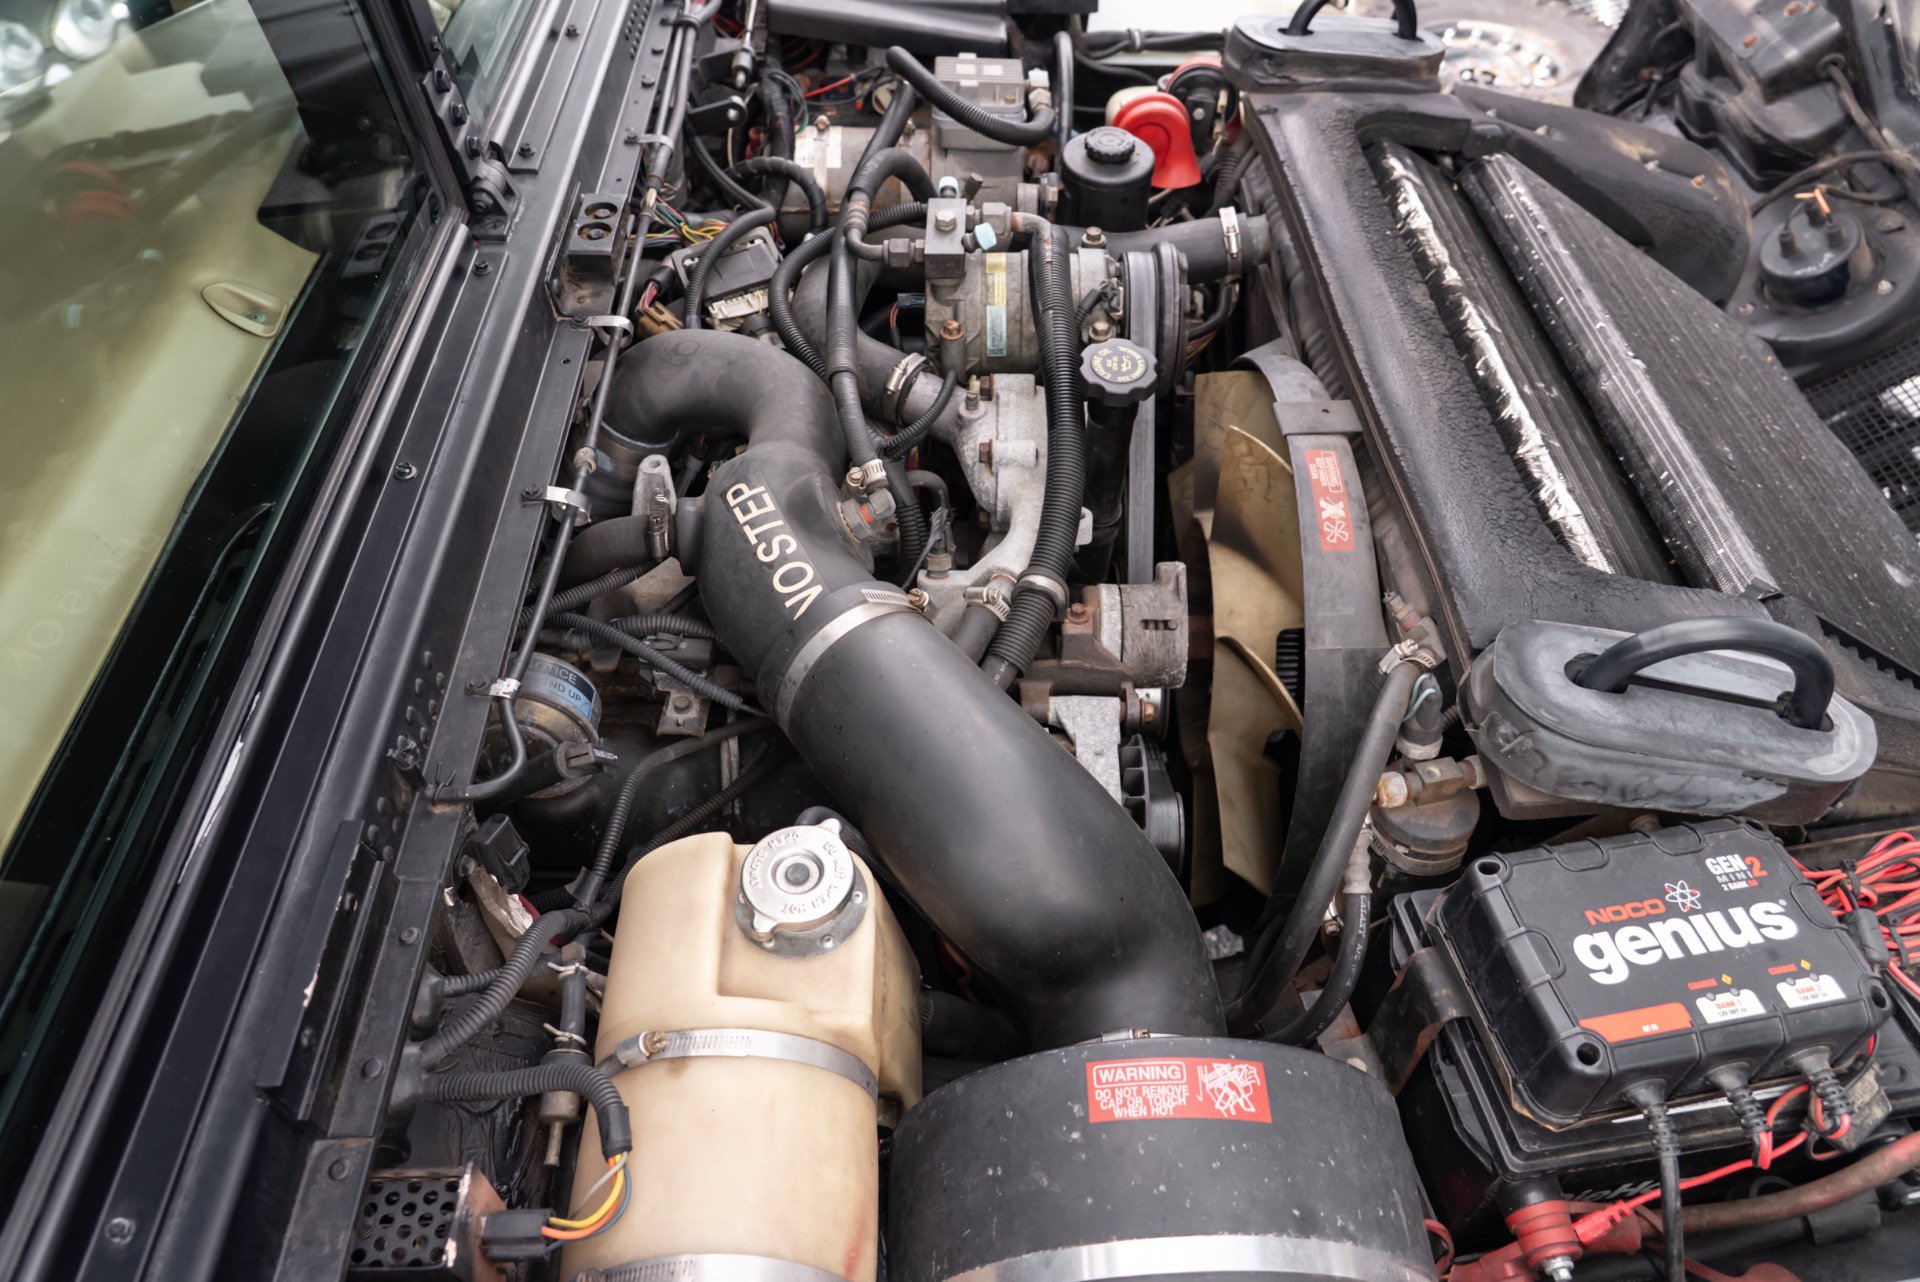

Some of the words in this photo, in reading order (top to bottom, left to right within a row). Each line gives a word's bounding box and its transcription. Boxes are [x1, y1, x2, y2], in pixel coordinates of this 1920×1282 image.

[1092, 355, 1111, 379] ENGINE
[1324, 456, 1340, 487] WARNING
[726, 482, 823, 621] VOSTEP
[568, 689, 582, 700] UP
[1716, 870, 1753, 883] MINI
[1722, 883, 1730, 891] 2
[1728, 880, 1749, 890] BANK
[1359, 894, 1367, 939] GALAXY
[1584, 898, 1666, 926] NOCO
[1573, 901, 1798, 985] genius
[1795, 986, 1814, 994] BANK
[1715, 1001, 1735, 1010] BANK
[1098, 1066, 1181, 1083] WARNING
[1095, 1089, 1111, 1101] DO
[1114, 1086, 1138, 1099] NOT
[1141, 1085, 1189, 1098] REMOVE
[1100, 1097, 1123, 1110] CAP
[1126, 1096, 1143, 1108] OR
[1148, 1094, 1187, 1106] TOUCH
[1113, 1105, 1147, 1118] WHEN
[1151, 1104, 1174, 1116] HOT
